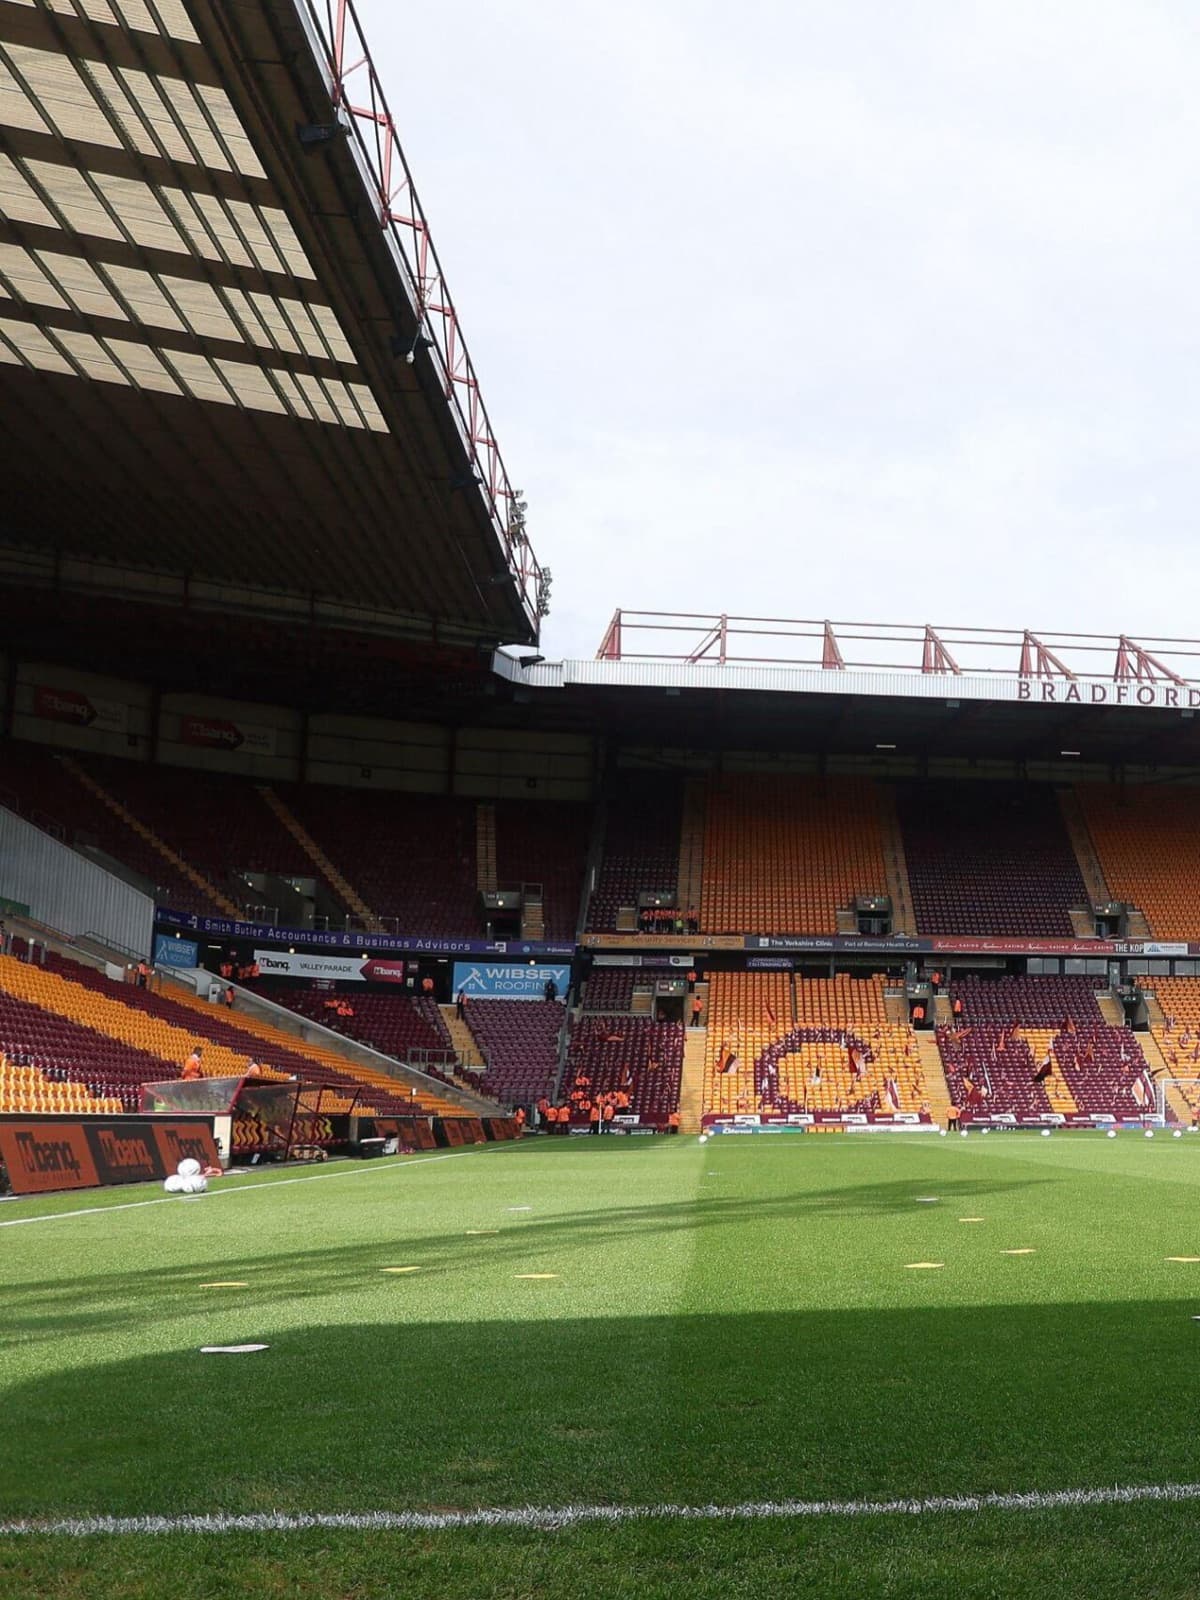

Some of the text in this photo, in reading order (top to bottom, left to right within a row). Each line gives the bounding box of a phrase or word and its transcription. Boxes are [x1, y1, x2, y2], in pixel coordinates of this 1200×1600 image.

[204, 919, 471, 951] Smith Butler Accountants & Business Advisors
[771, 939, 784, 947] The
[784, 939, 814, 947] Yorkshire
[1114, 943, 1144, 953] THE KOP
[299, 962, 324, 971] VALLEY
[323, 963, 353, 973] PARADE
[486, 967, 565, 980] WIBSEY
[494, 981, 553, 991] ROOFIN
